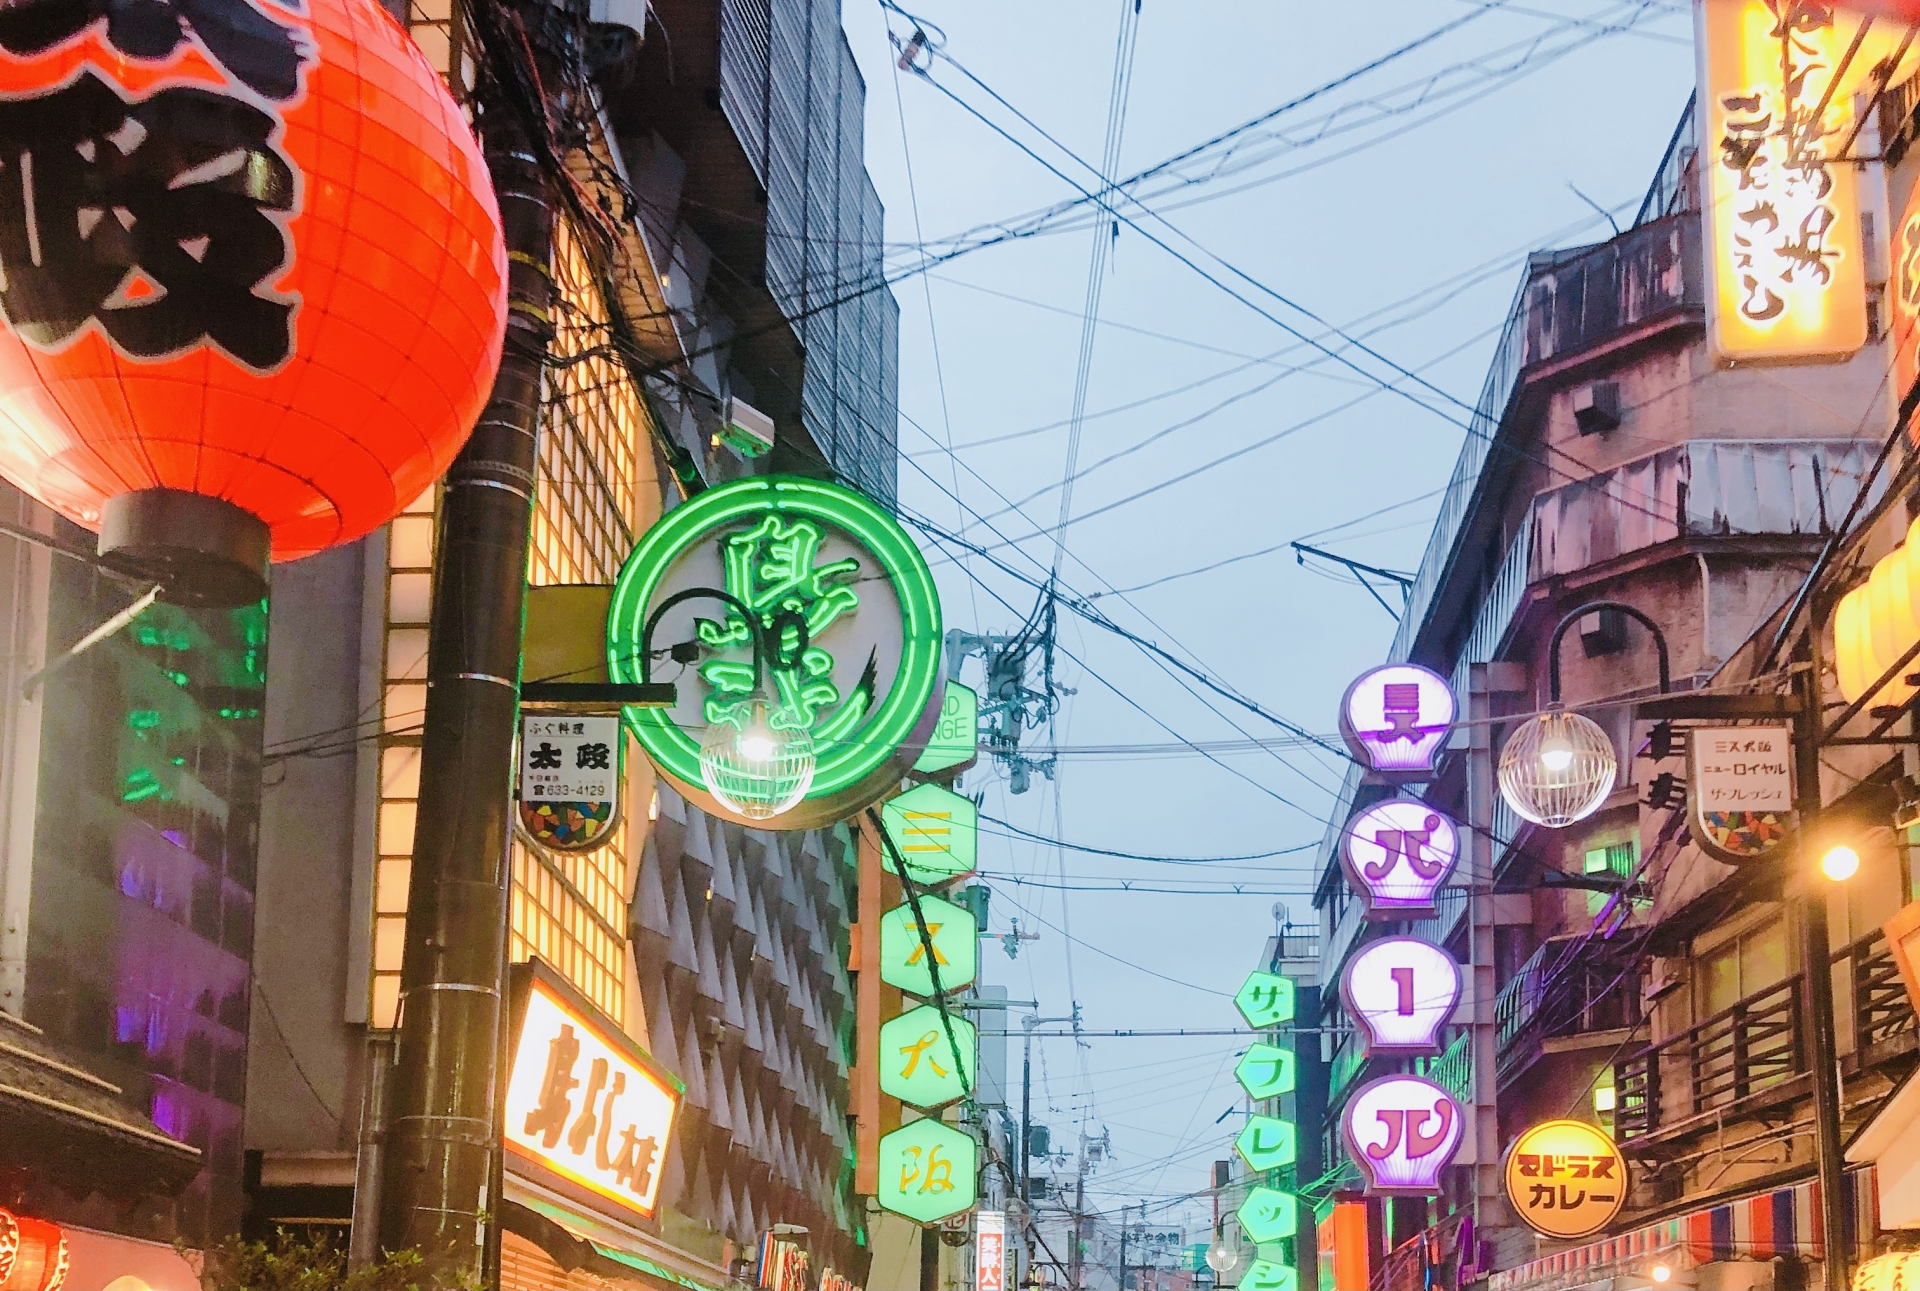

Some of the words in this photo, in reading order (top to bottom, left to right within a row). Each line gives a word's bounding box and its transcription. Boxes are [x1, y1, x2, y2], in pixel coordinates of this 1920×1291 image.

[530, 723, 584, 735] ふぐ料理
[1704, 763, 1786, 775] ニューロイヤル
[547, 785, 604, 796] 633-4129
[1518, 1154, 1615, 1179] マドラス
[1529, 1183, 1614, 1210] カレー
